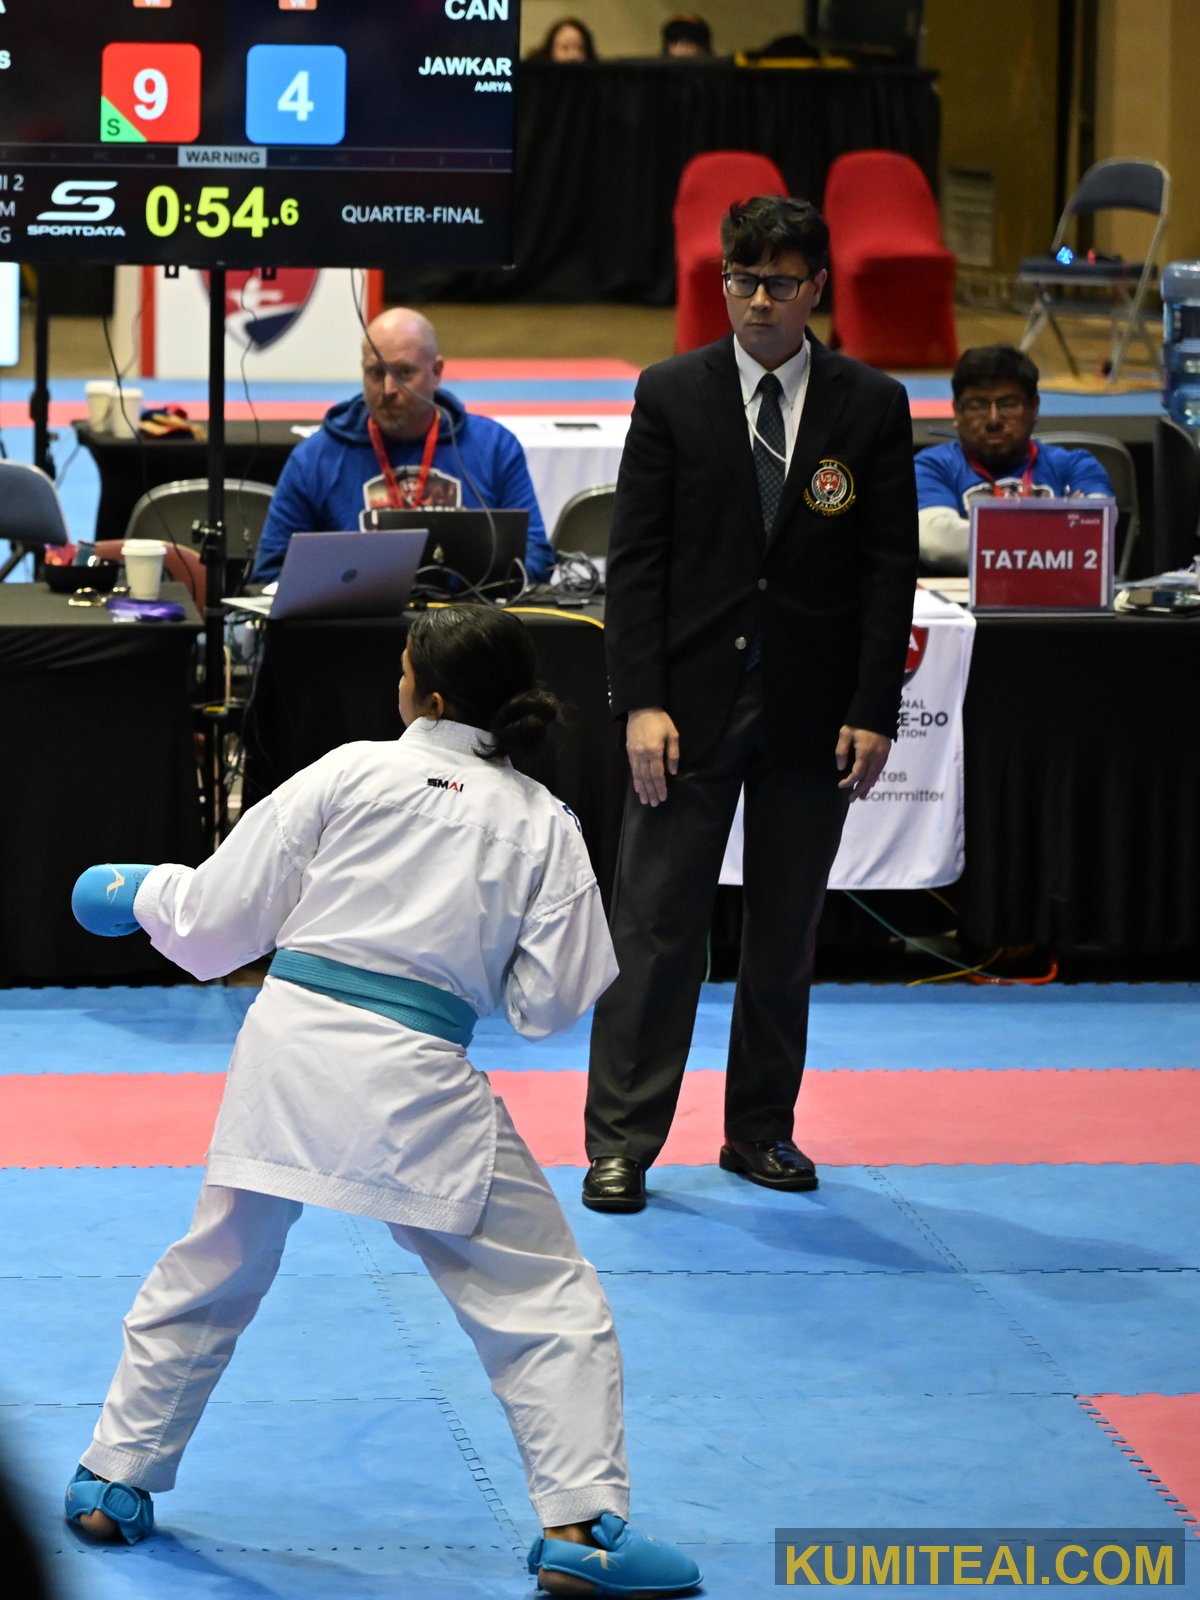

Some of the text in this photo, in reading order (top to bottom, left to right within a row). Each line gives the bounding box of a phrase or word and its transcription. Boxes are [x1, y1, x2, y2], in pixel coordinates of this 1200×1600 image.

[444, 0, 509, 21] CAN
[418, 56, 512, 76] JAWKAR
[133, 68, 168, 120] 9
[277, 70, 314, 122] 4
[106, 118, 120, 136] S
[186, 151, 260, 164] WARNING
[12, 174, 25, 192] 2
[341, 204, 485, 224] QUARTER-FINAL
[26, 225, 127, 237] SPORTDATA
[981, 549, 1098, 570] TATAMI 2
[427, 778, 464, 793] SMAI
